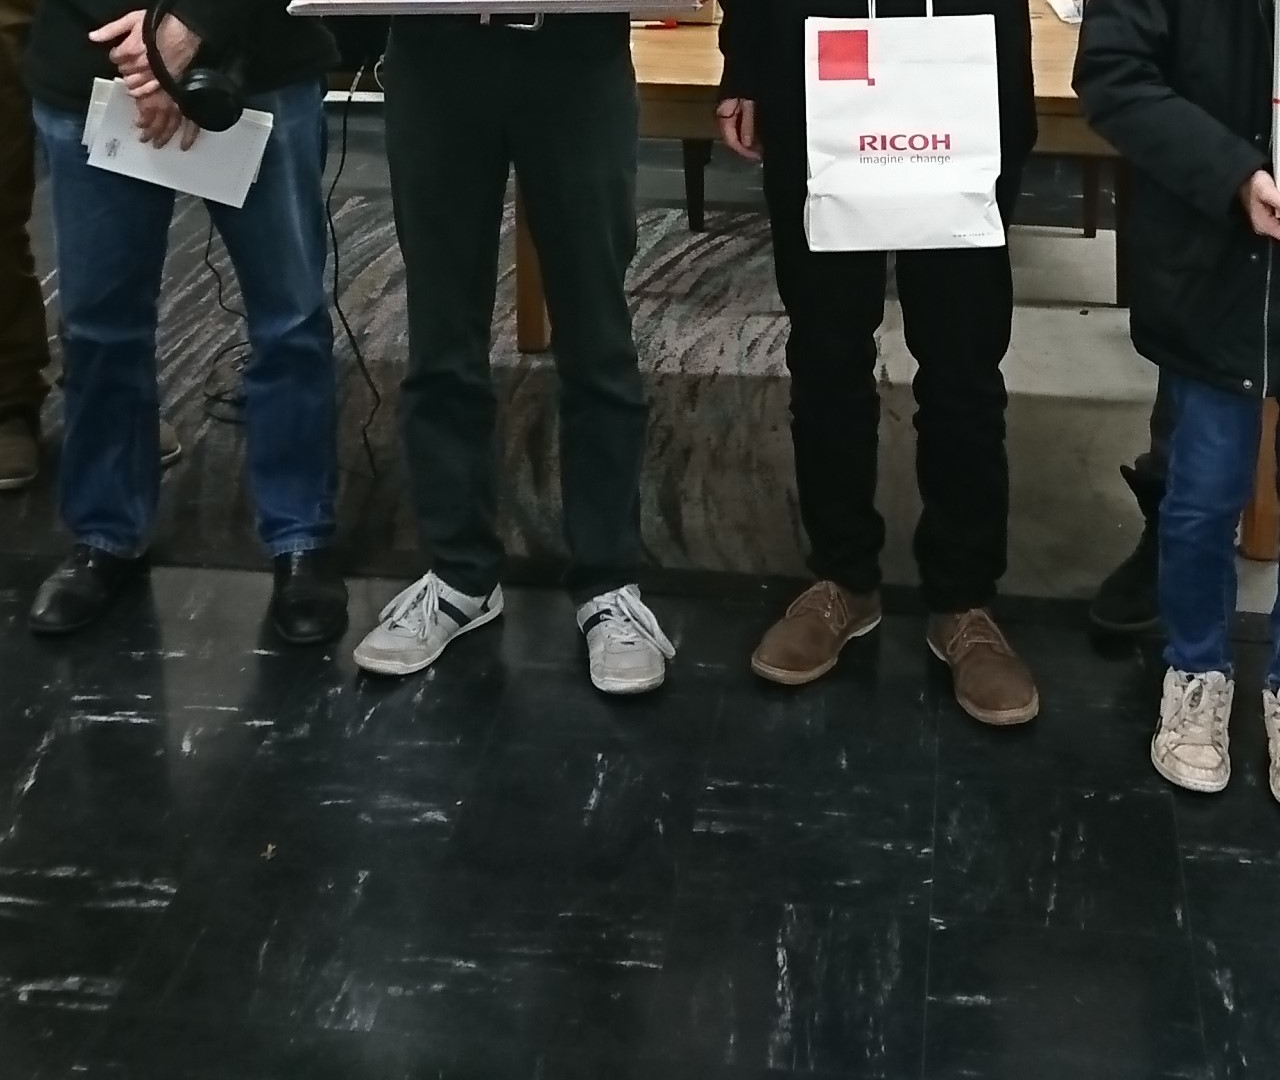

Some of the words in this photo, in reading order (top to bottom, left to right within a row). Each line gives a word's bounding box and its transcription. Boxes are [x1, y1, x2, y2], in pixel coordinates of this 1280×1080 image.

[859, 133, 951, 151] RICOH
[859, 154, 904, 166] imagine
[909, 154, 954, 166] change.
